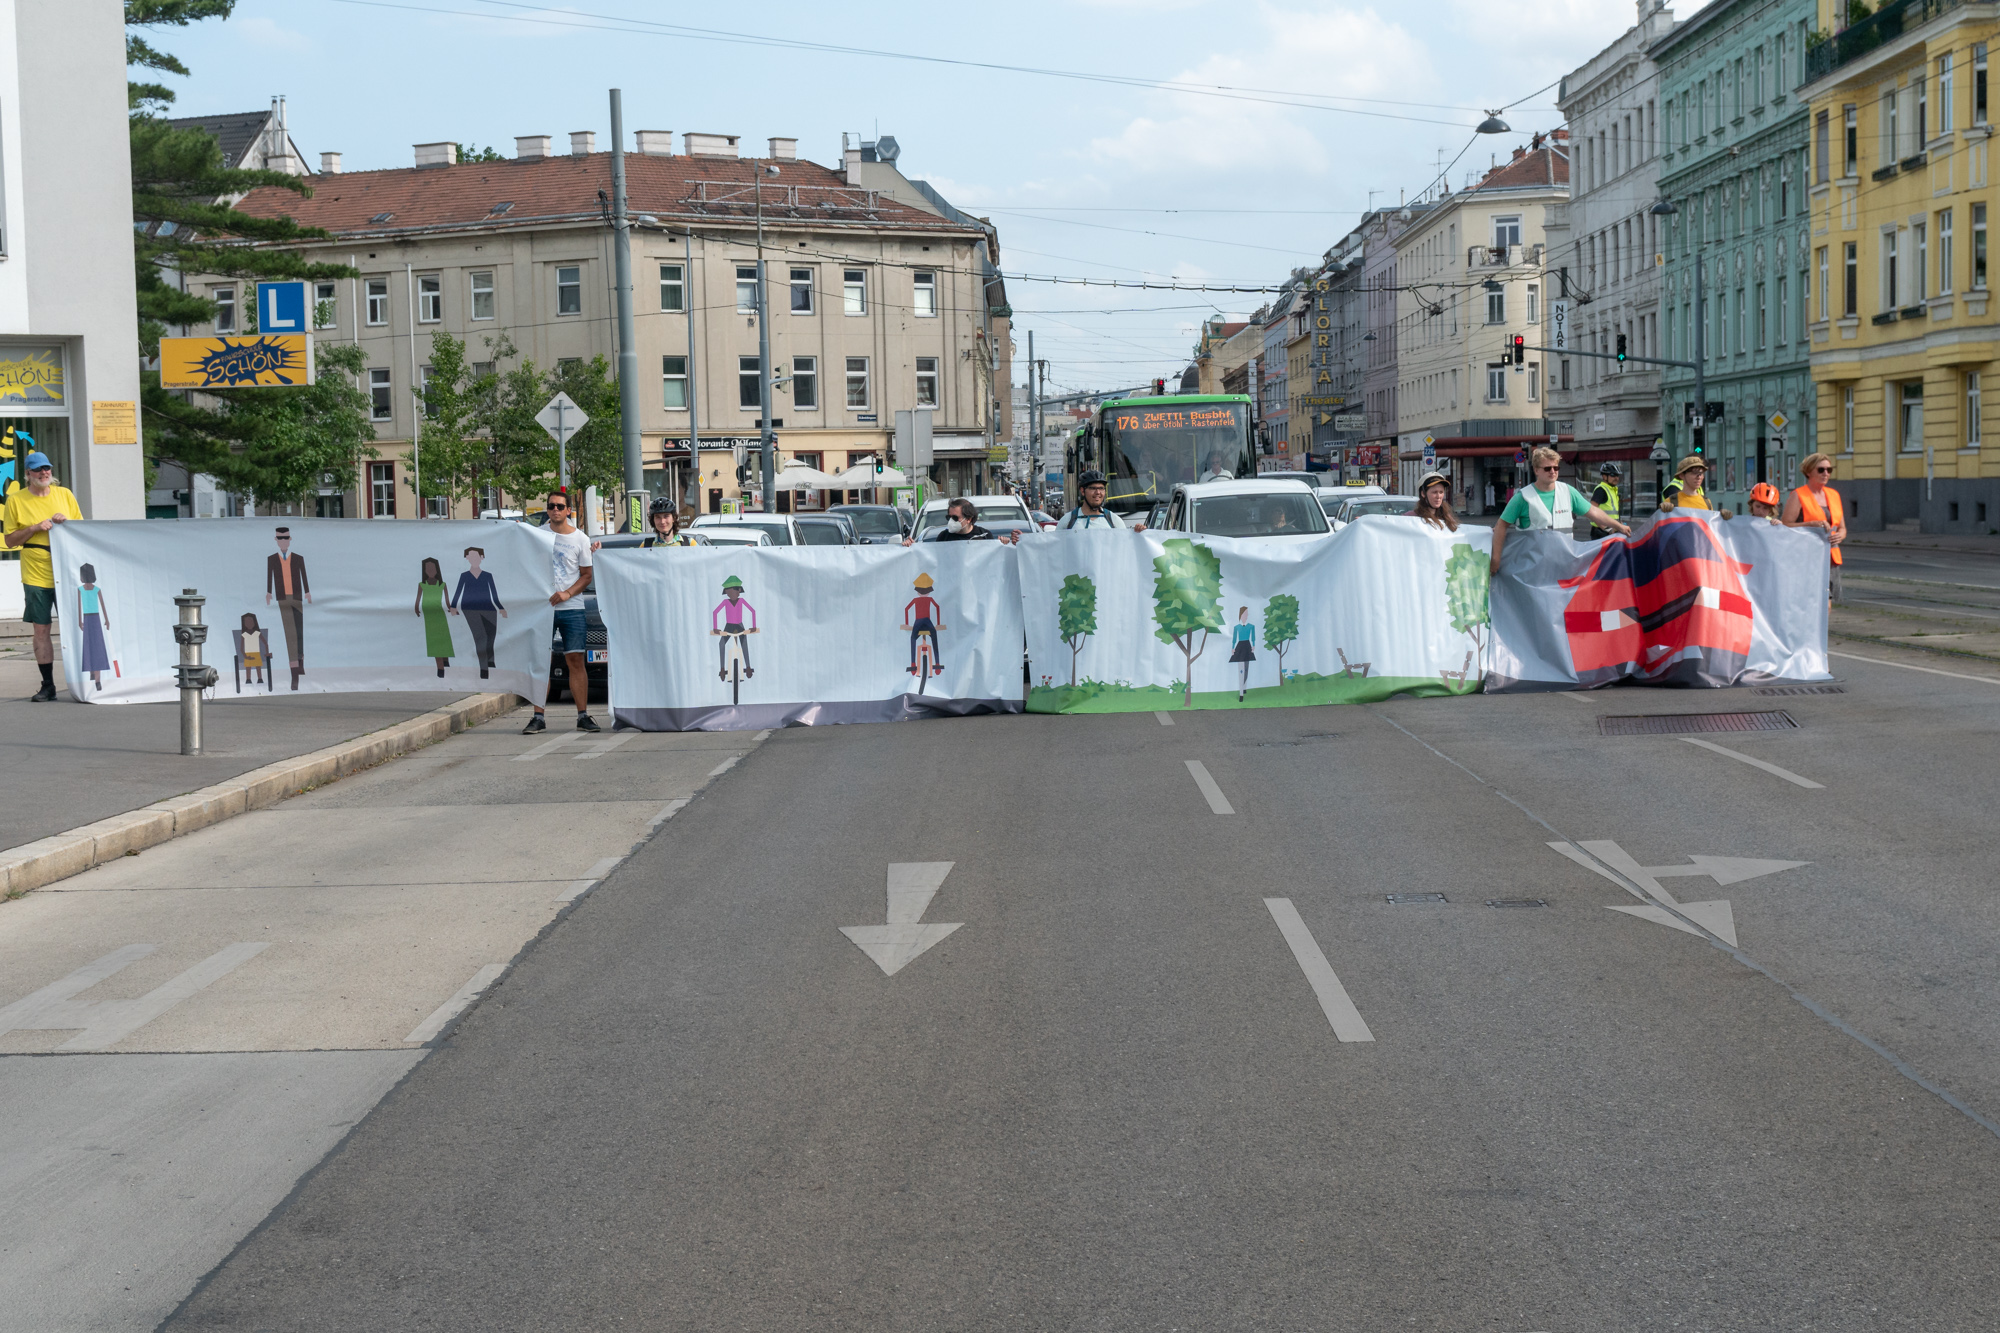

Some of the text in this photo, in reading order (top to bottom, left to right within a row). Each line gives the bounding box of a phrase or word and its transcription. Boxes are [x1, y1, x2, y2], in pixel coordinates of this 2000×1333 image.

[268, 289, 295, 327] L
[1316, 280, 1332, 383] GLORIA
[1555, 305, 1564, 347] NOTAR
[206, 350, 281, 382] SCHÖN
[1304, 396, 1345, 405] Theater
[1117, 410, 1234, 430] 176 ZWETTL Busbhf.
[1191, 418, 1235, 427] Rastenfeld
